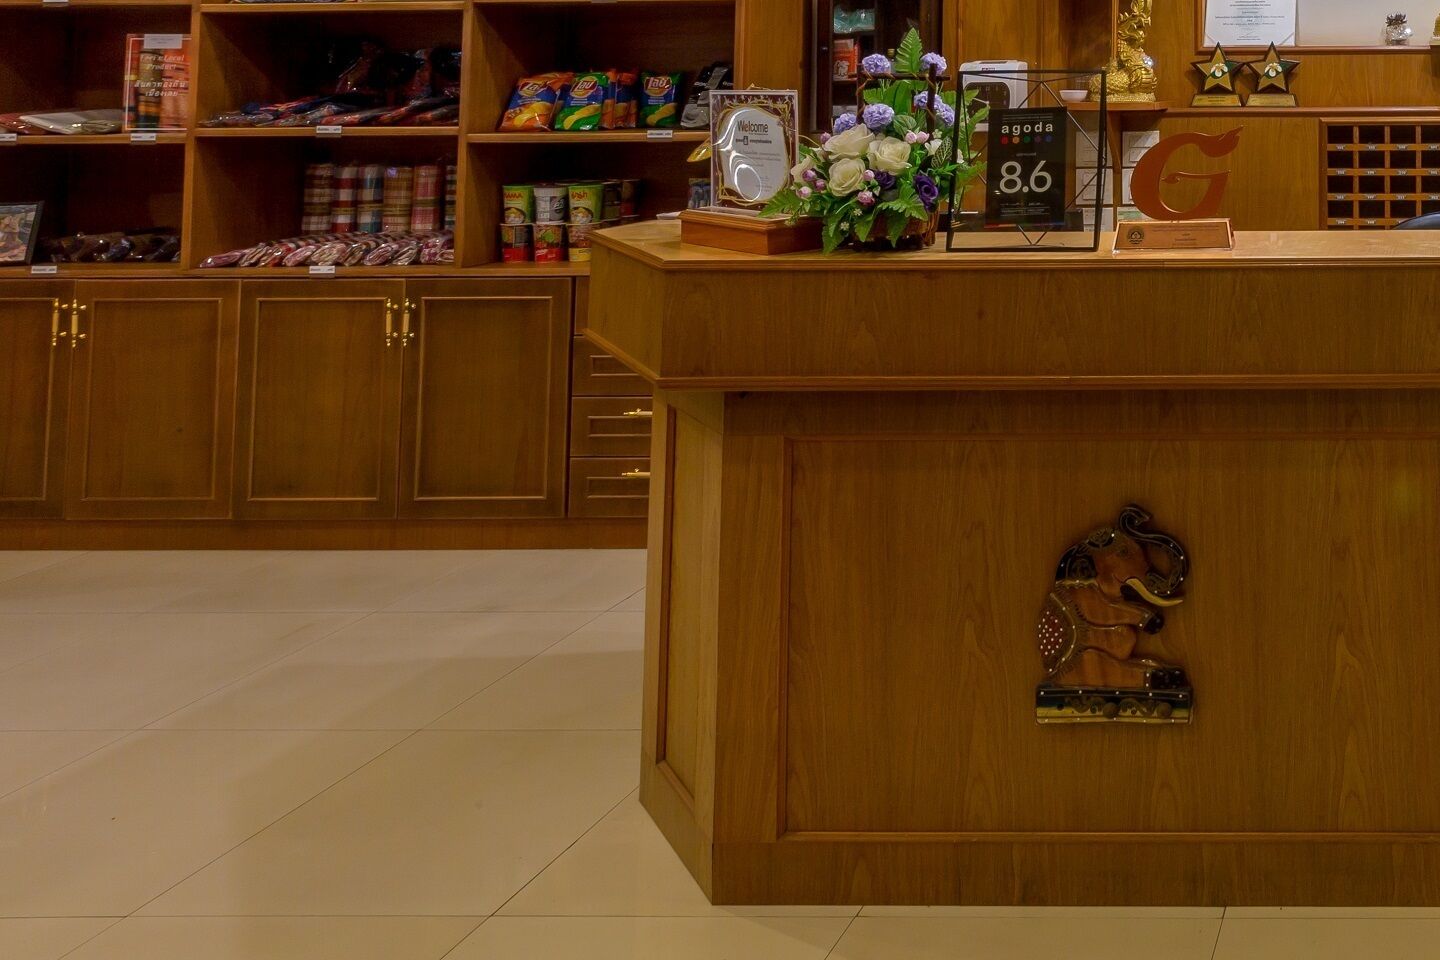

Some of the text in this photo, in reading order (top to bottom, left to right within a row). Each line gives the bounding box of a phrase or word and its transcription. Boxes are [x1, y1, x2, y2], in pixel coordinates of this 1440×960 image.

[737, 120, 769, 133] Welcome
[1001, 121, 1054, 136] agoda
[999, 160, 1052, 194] 8.6
